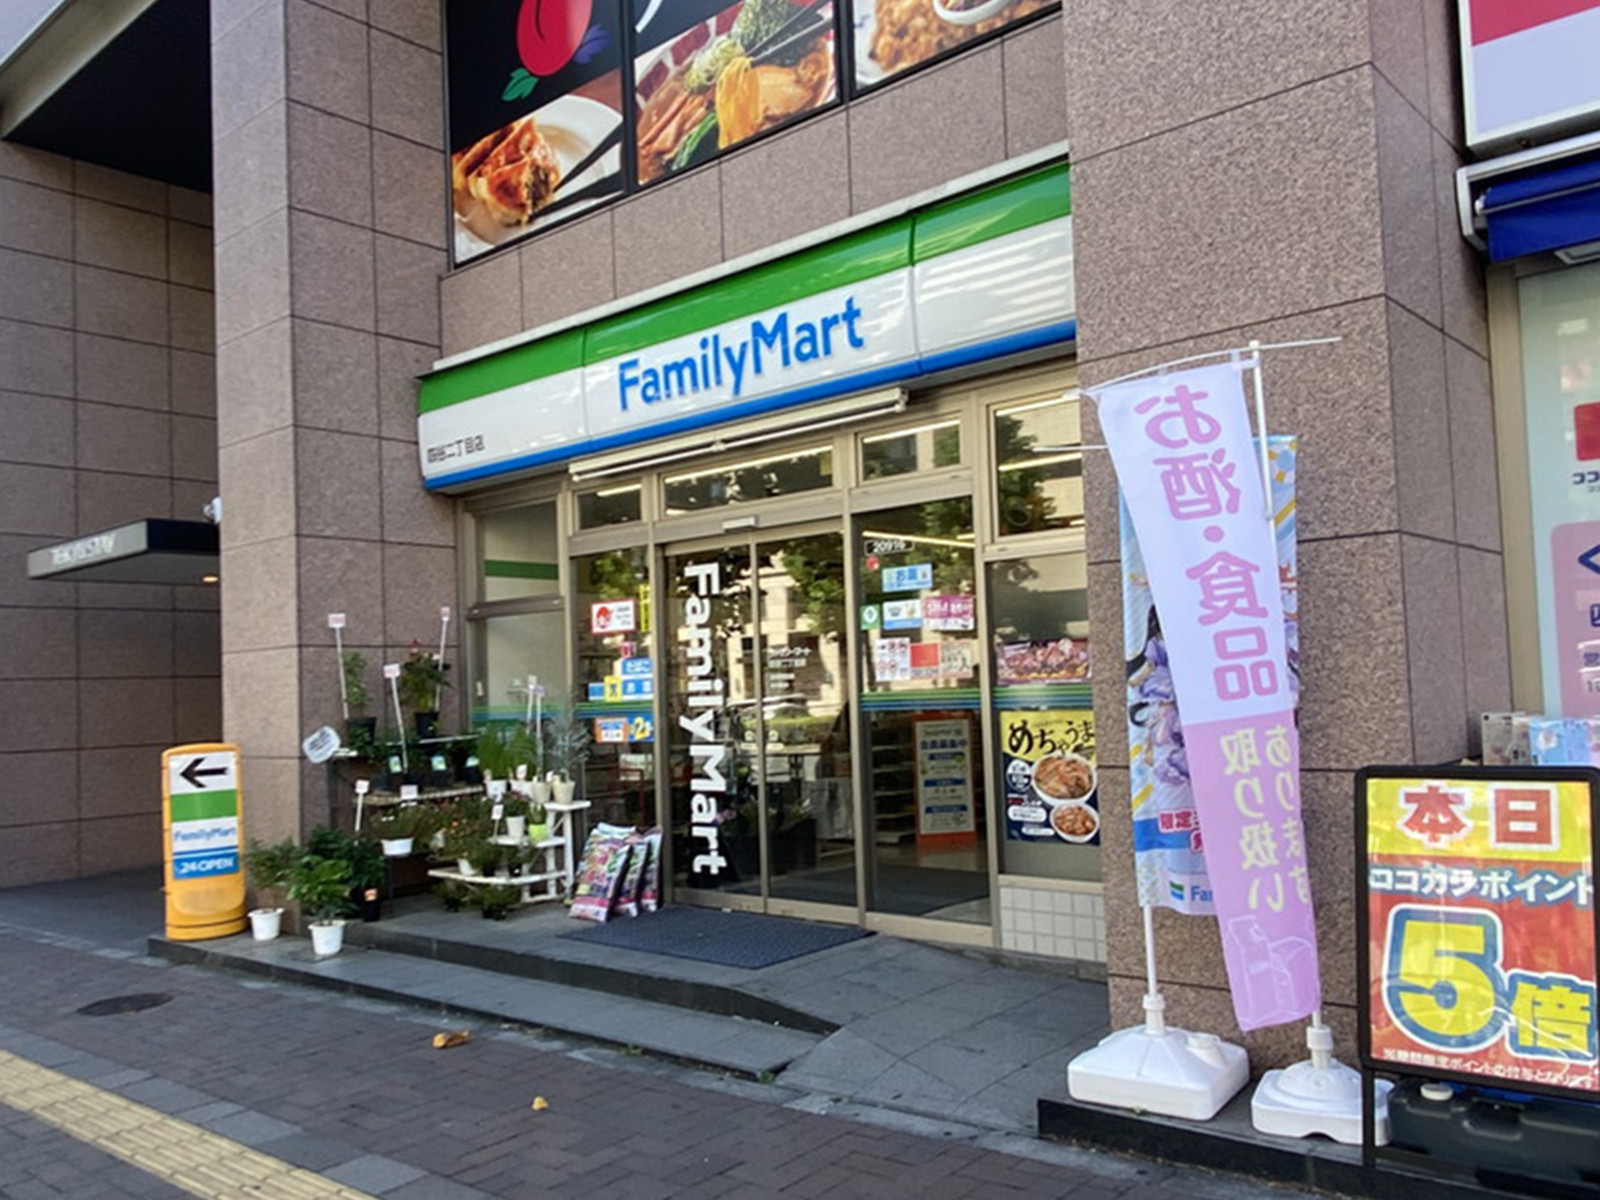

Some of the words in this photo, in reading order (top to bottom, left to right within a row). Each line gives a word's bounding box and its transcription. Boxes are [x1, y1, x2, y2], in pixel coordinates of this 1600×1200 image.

[618, 296, 864, 411] FamilyMart
[680, 561, 728, 877] FamilyMart
[1400, 781, 1556, 848] 本日
